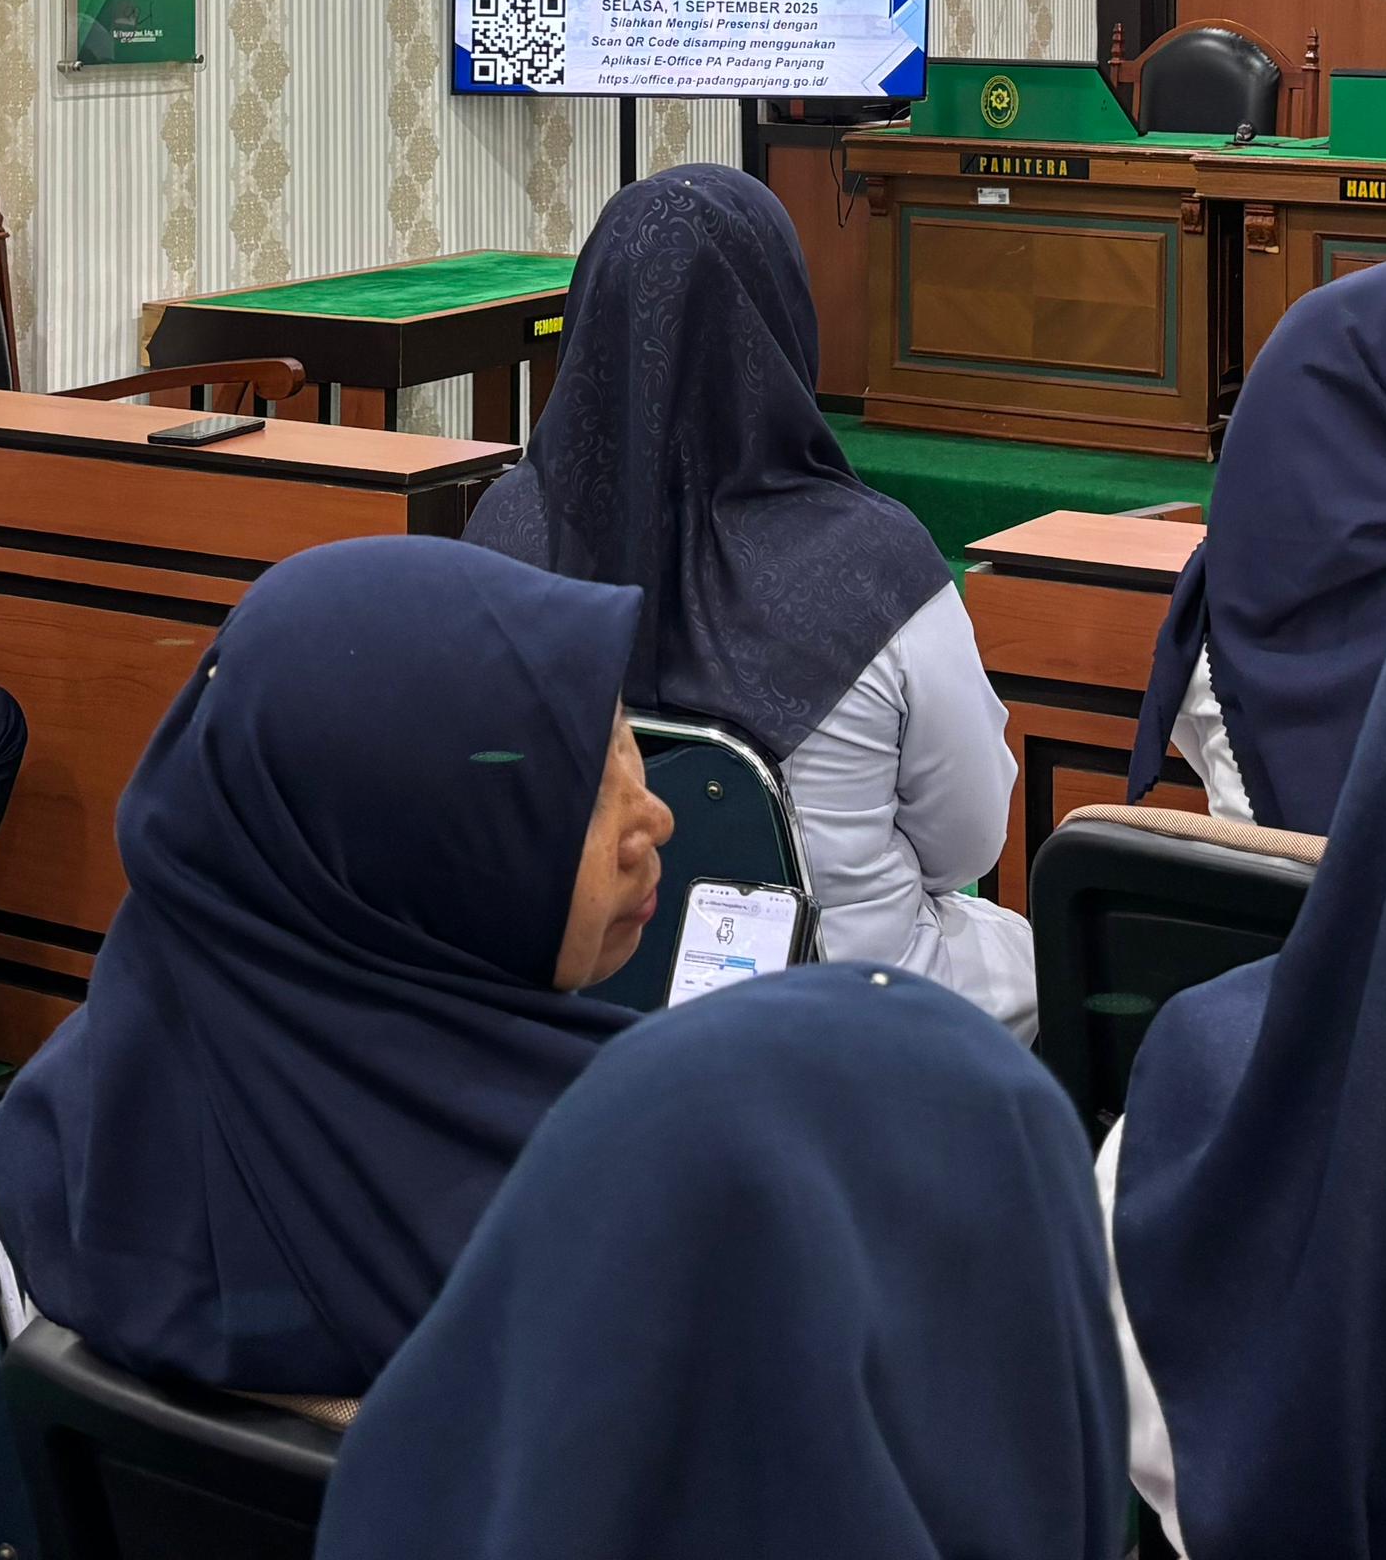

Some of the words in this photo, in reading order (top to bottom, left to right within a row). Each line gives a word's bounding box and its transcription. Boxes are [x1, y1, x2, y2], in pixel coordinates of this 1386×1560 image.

[602, 0, 668, 14] SELASA,
[673, 1, 680, 13] 1
[686, 1, 780, 14] SEPTEMBER
[784, 2, 819, 14] 2025
[610, 17, 662, 28] Silahkan
[666, 18, 713, 30] Mengisi
[716, 19, 770, 30] Presensi
[773, 20, 818, 32] dengan
[591, 36, 622, 47] Scan
[625, 37, 644, 47] QR
[648, 37, 680, 47] Code
[683, 37, 746, 50] disamping
[750, 39, 836, 52] menggunakan
[601, 56, 651, 67] Aplikasi
[654, 56, 702, 67] E-Office
[706, 57, 722, 67] PA
[726, 57, 772, 70] Padang
[775, 58, 825, 70] Panjang
[979, 156, 1068, 176] PANITERA
